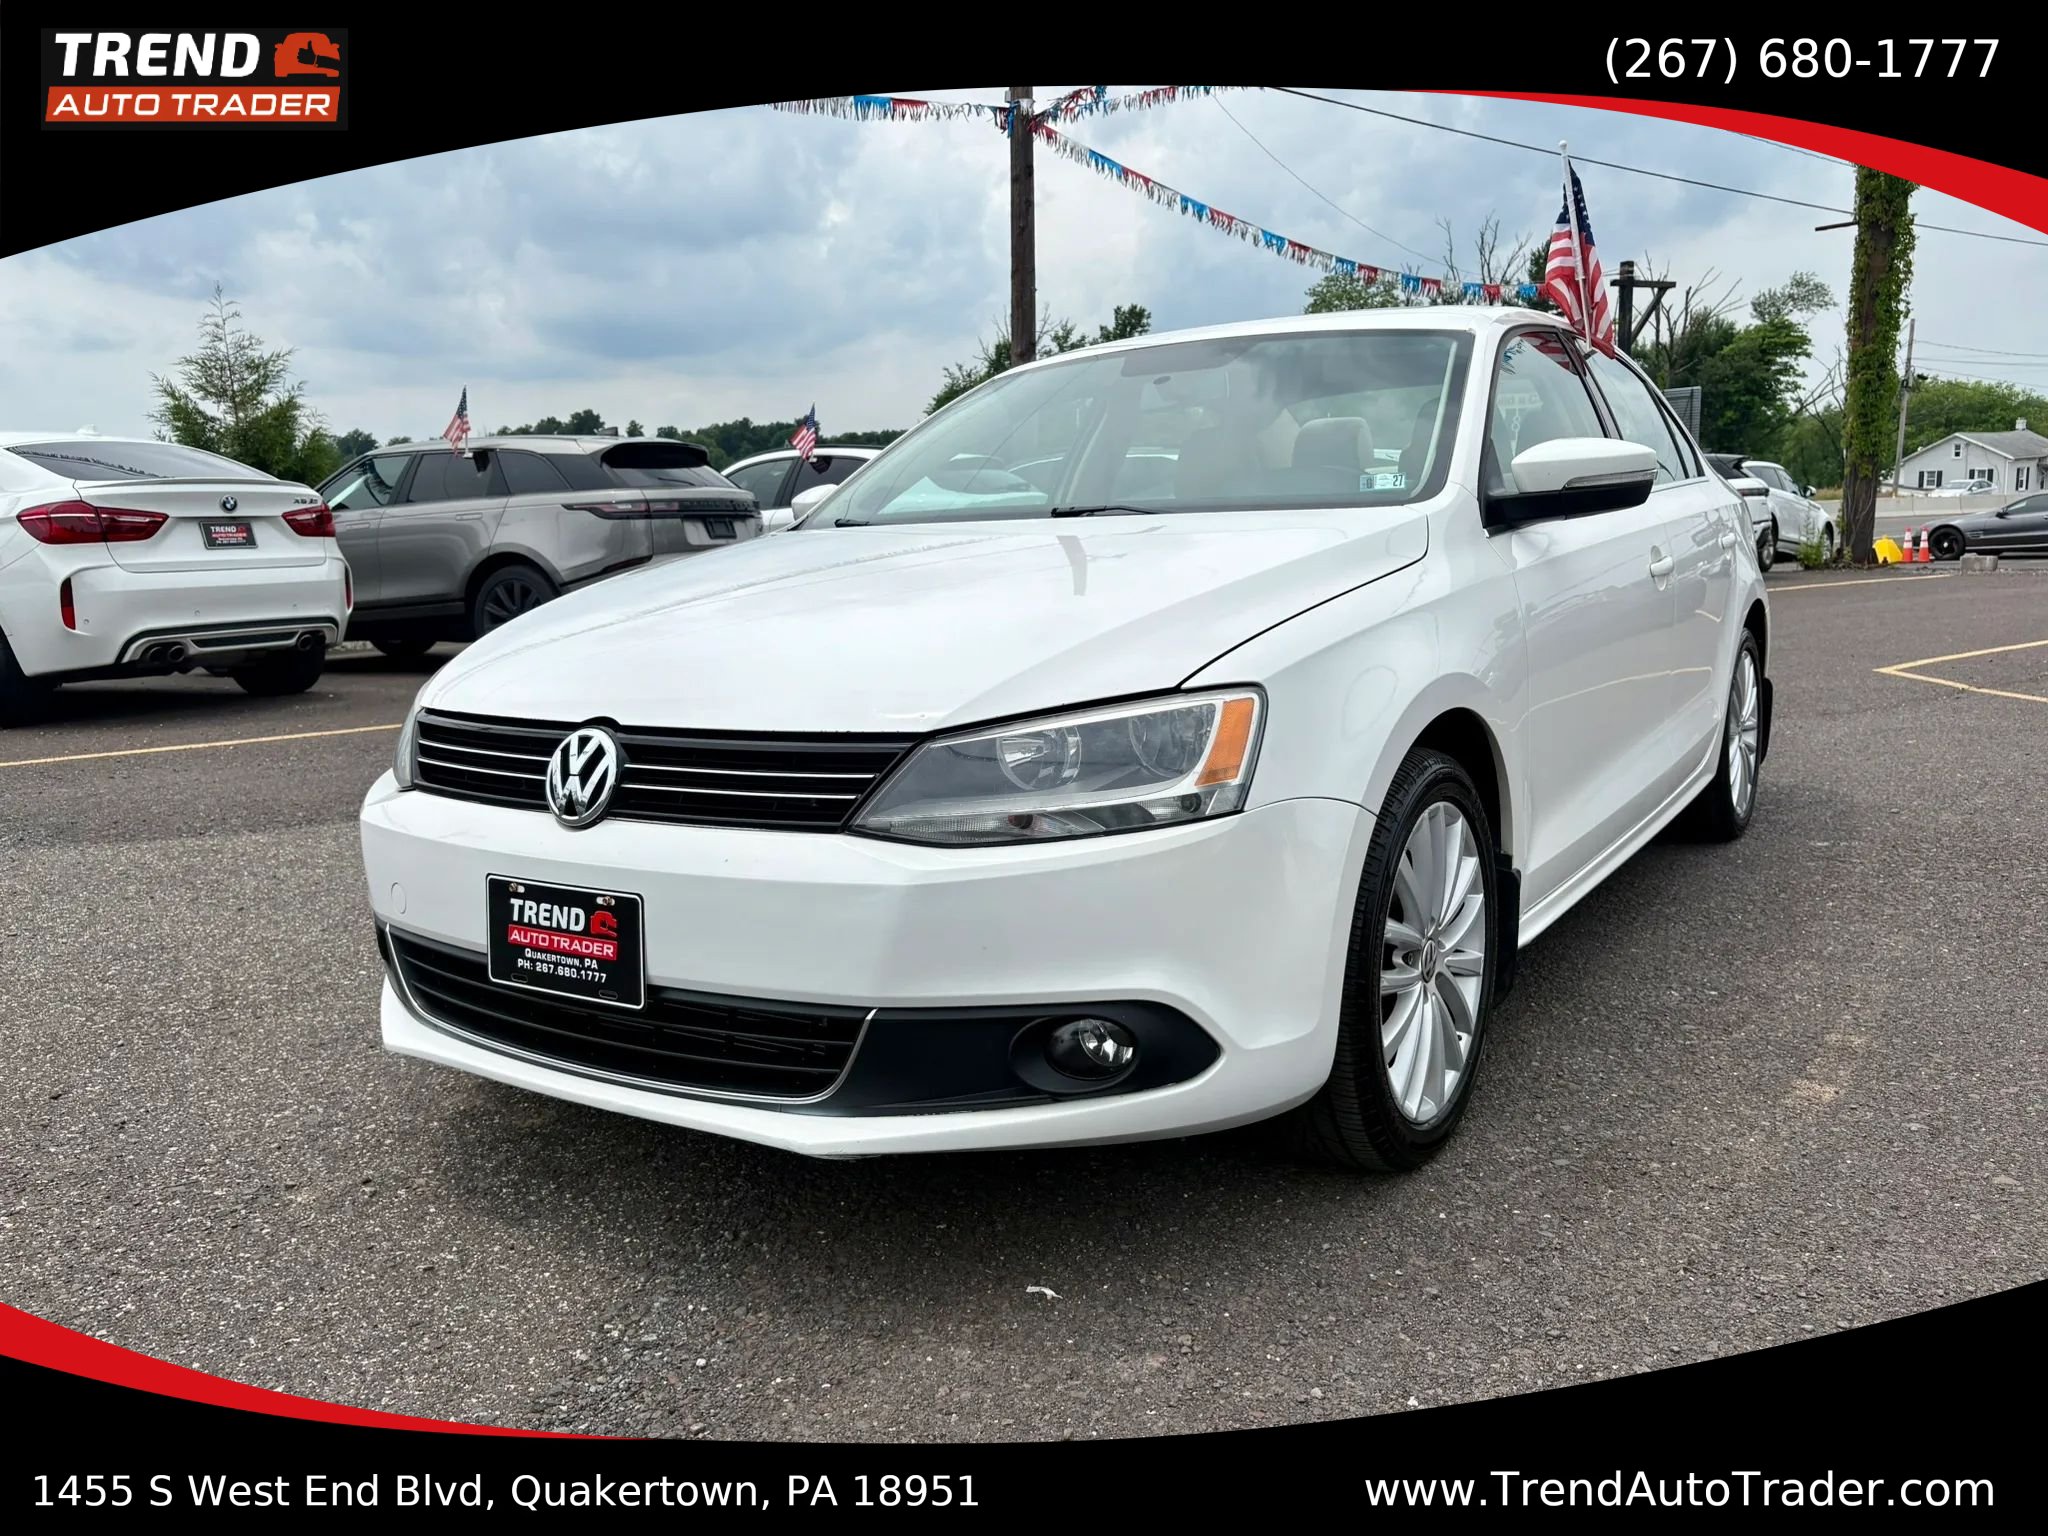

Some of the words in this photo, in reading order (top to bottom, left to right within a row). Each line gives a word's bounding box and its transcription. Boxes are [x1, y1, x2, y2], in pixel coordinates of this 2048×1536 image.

[1392, 474, 1404, 487] 27
[548, 730, 615, 823] VW
[509, 897, 586, 932] TREND
[509, 929, 549, 947] AUTO
[550, 935, 614, 957] TRADER
[517, 958, 534, 970] PH:
[535, 961, 607, 984] 267.680.1777
[584, 957, 599, 970] PA
